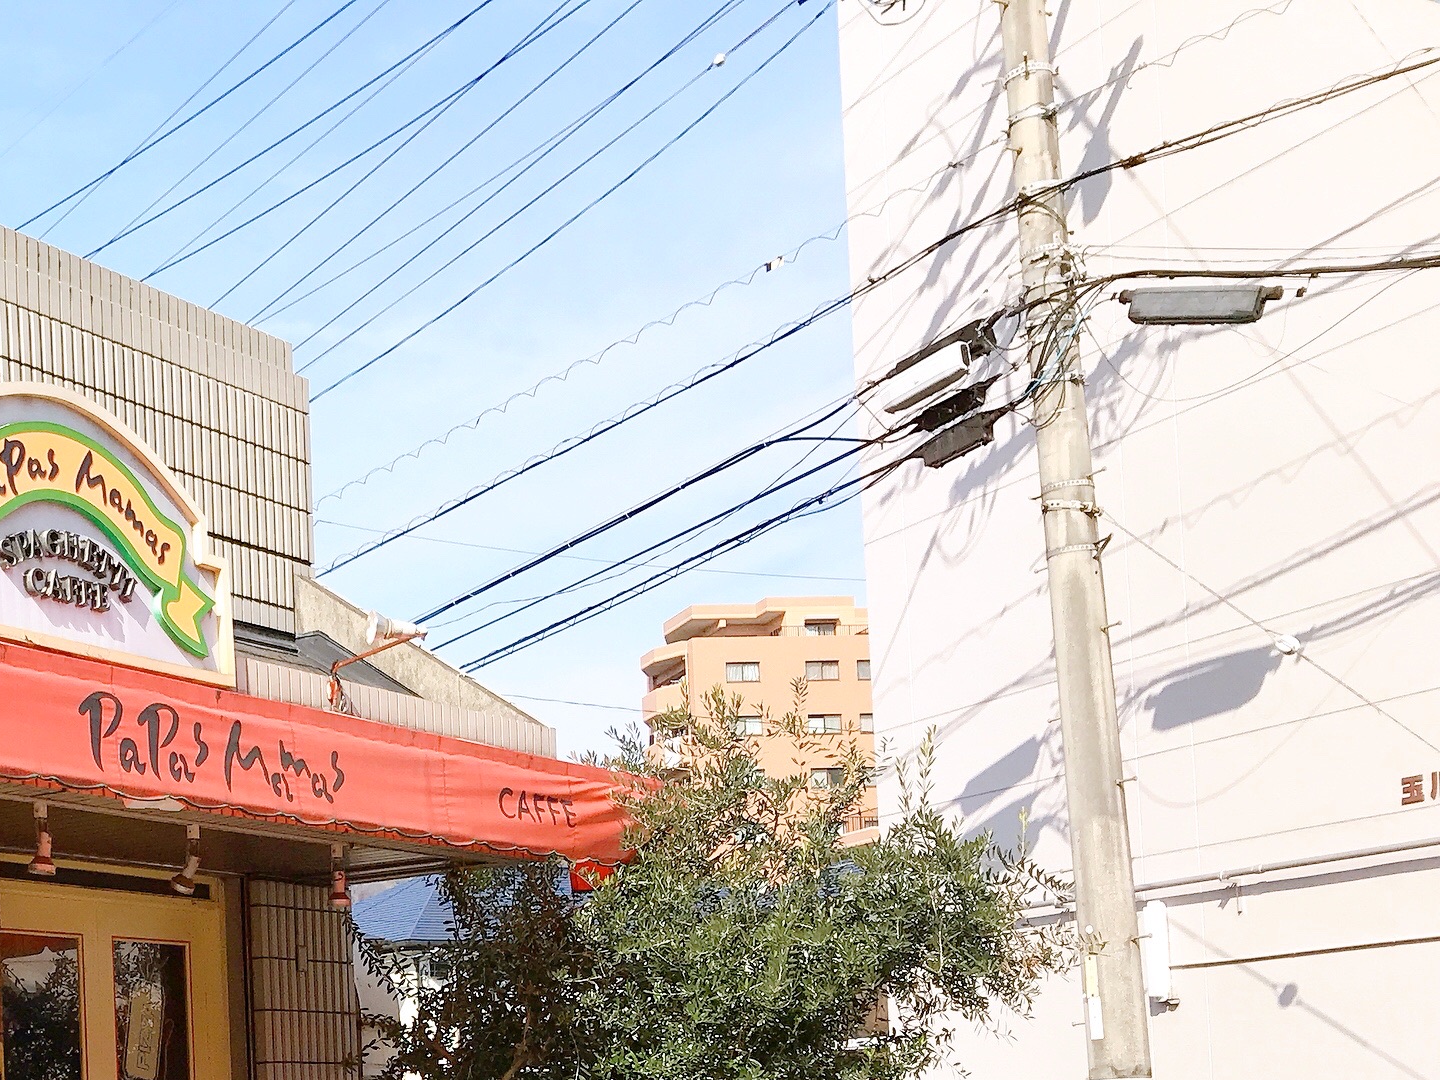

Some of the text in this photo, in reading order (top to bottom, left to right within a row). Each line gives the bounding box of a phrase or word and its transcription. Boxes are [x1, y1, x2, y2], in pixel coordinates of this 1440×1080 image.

[75, 450, 171, 565] Mamas
[23, 567, 111, 613] CAFFE
[223, 719, 345, 804] Mamas
[497, 786, 578, 829] CAFFE
